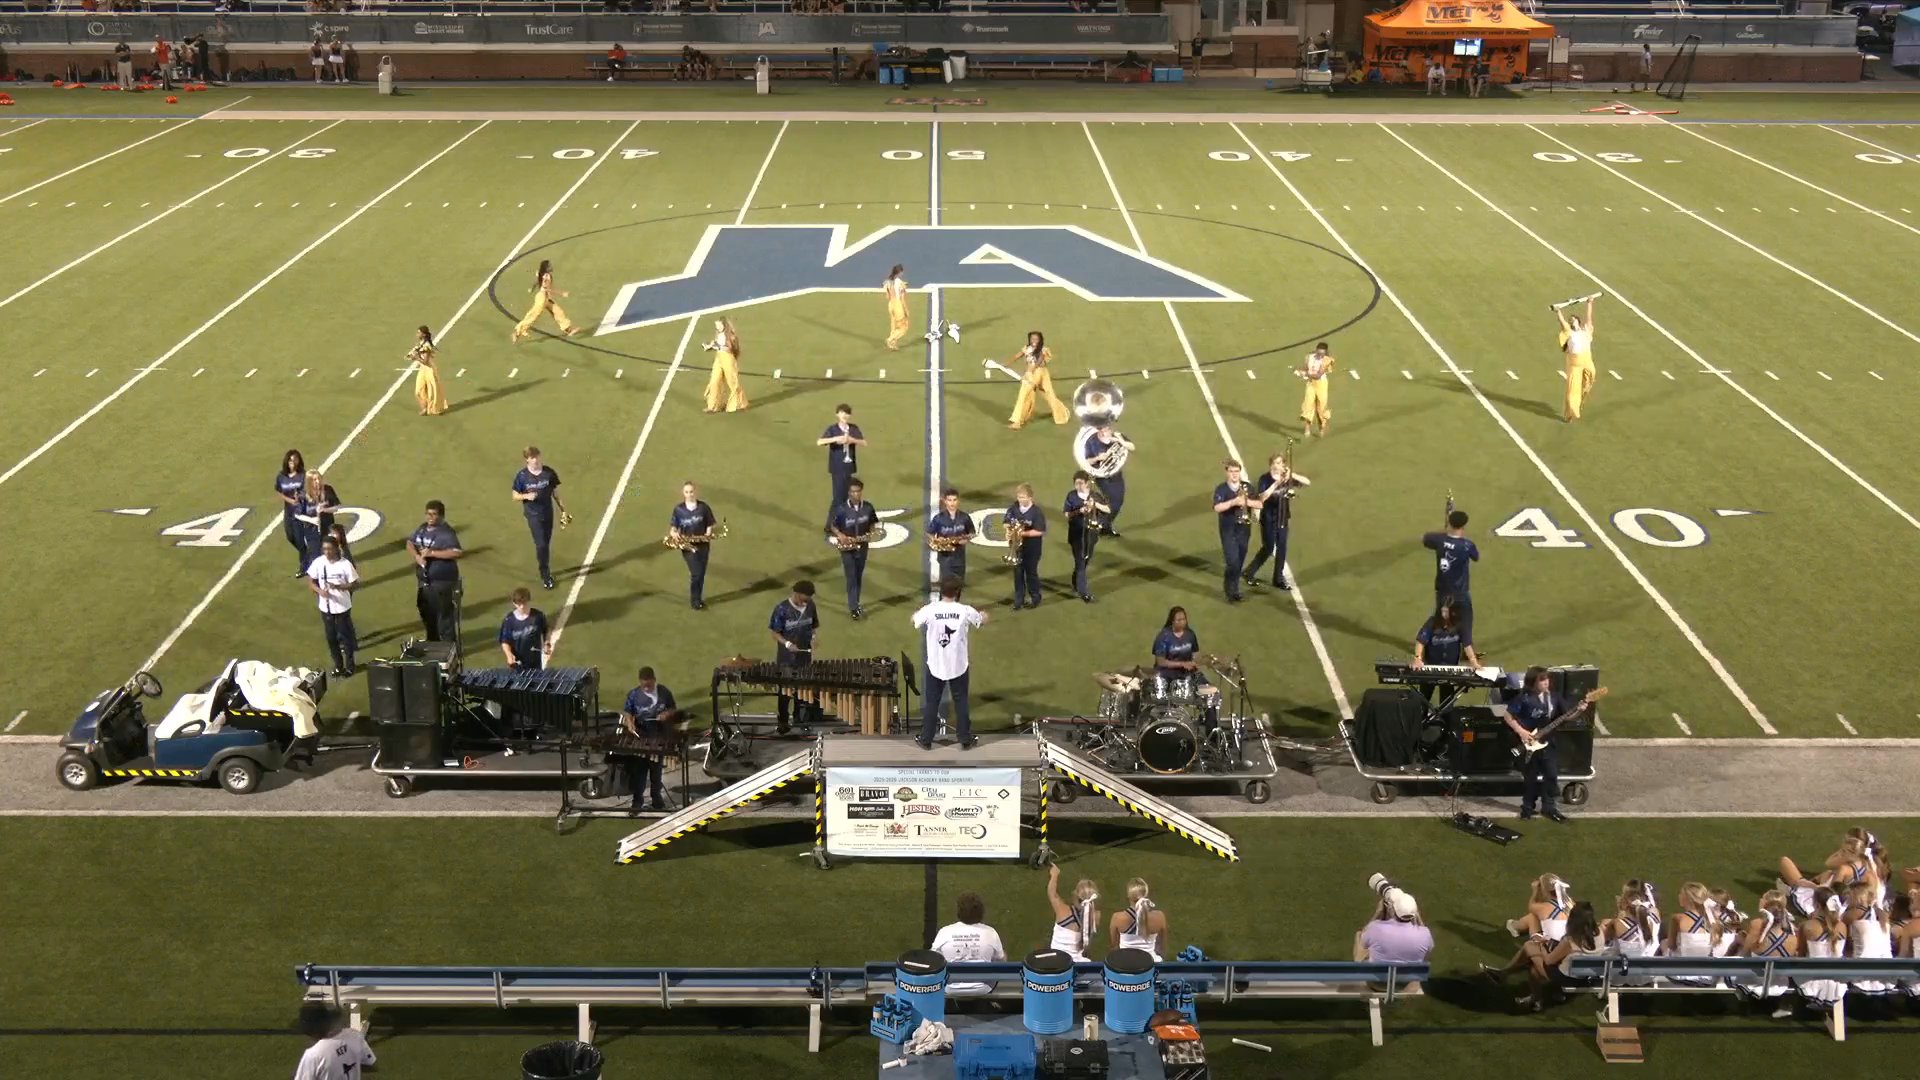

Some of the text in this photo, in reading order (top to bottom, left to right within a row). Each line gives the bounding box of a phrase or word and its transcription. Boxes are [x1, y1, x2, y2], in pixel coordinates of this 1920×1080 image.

[525, 24, 573, 35] TrustCare
[976, 25, 1009, 33] Trustmark
[1494, 507, 1707, 549] 40
[839, 787, 854, 795] 601
[860, 790, 888, 798] BRAVO!
[902, 804, 941, 816] HESTER'S
[914, 825, 947, 836] TANNER
[900, 982, 942, 993] POWERADE
[1027, 981, 1070, 993] POWERADE
[1109, 981, 1151, 993] POWERADE
